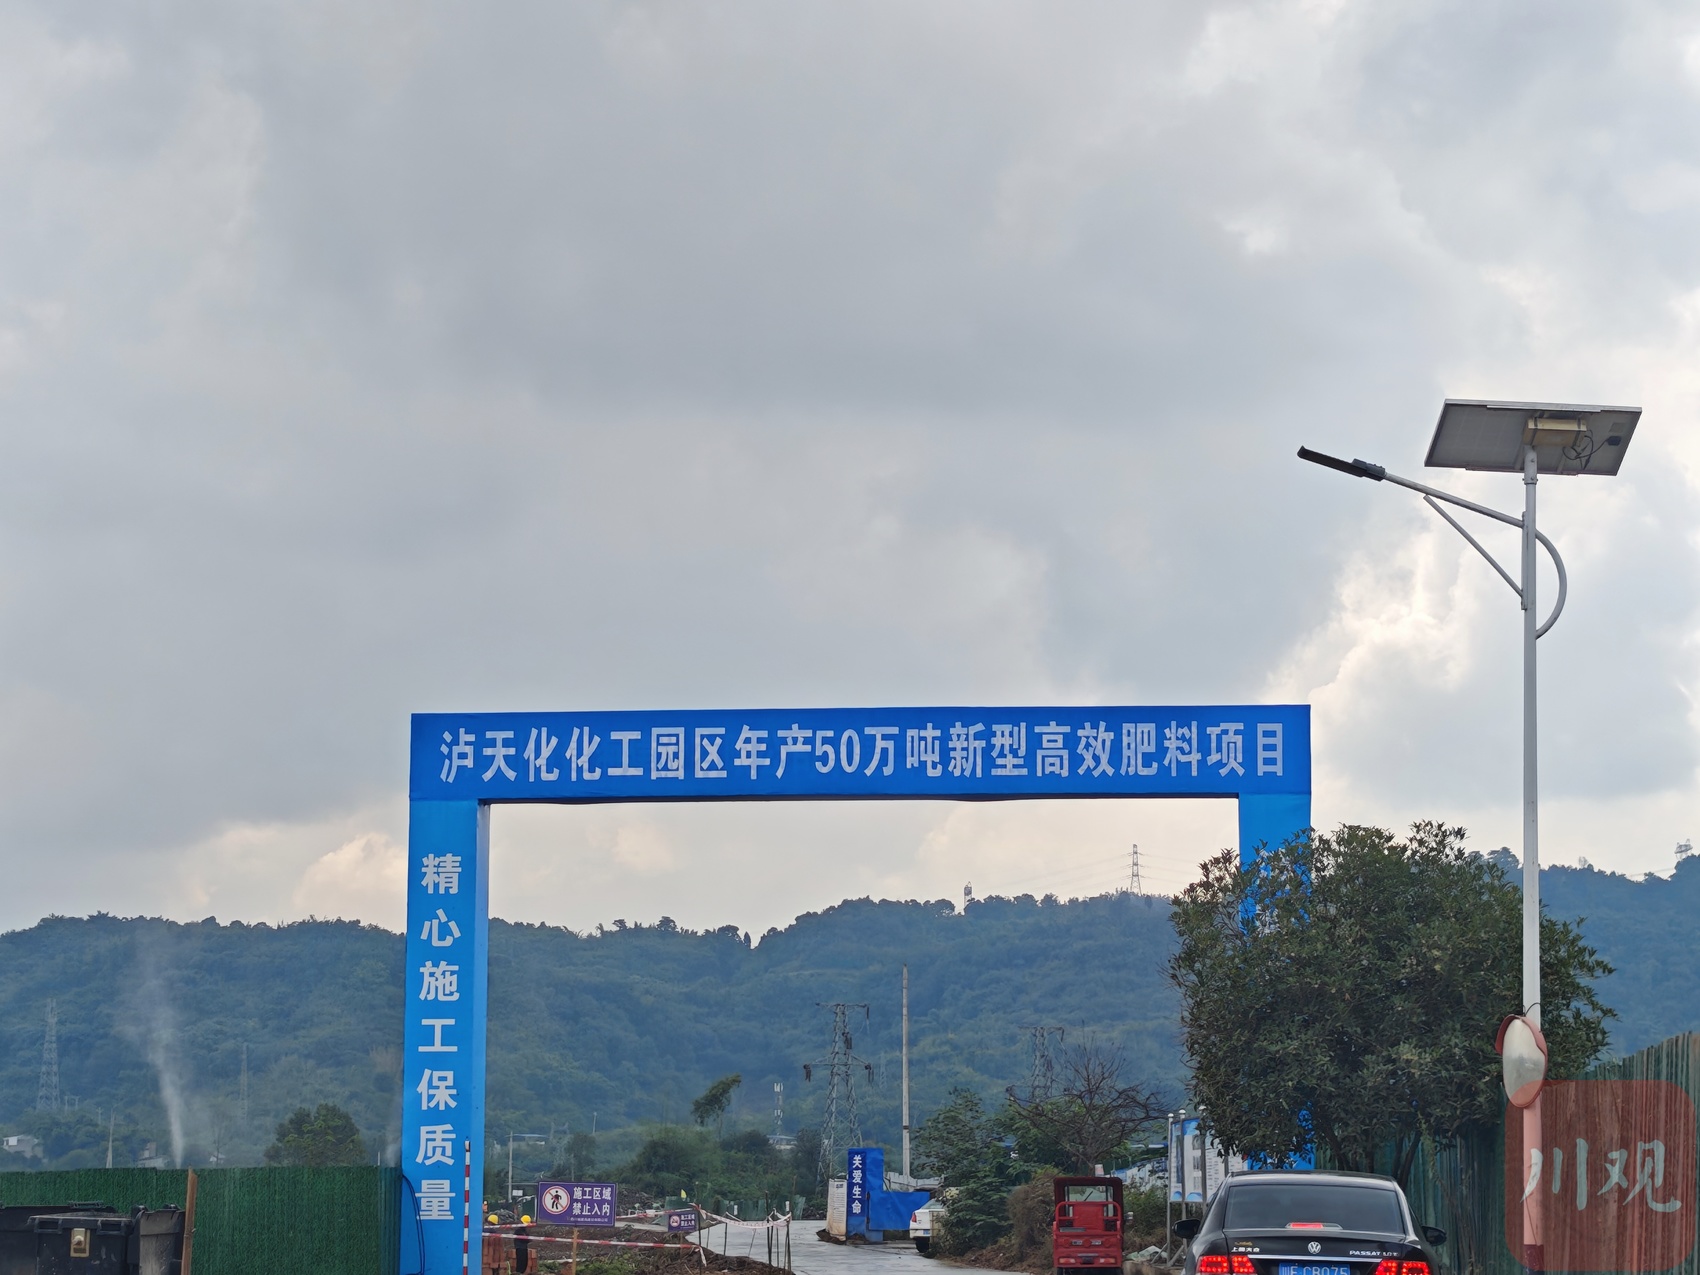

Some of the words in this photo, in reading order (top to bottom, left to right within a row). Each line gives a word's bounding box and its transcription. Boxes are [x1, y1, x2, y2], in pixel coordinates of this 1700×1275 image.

[440, 720, 1283, 783] 泸天化化工园区年产50万吨新型高效肥料项目
[415, 853, 462, 1220] 精心施工保质量
[572, 1202, 611, 1216] 禁止入内
[573, 1186, 612, 1201] 施工区域
[852, 1155, 862, 1214] 关爱生命
